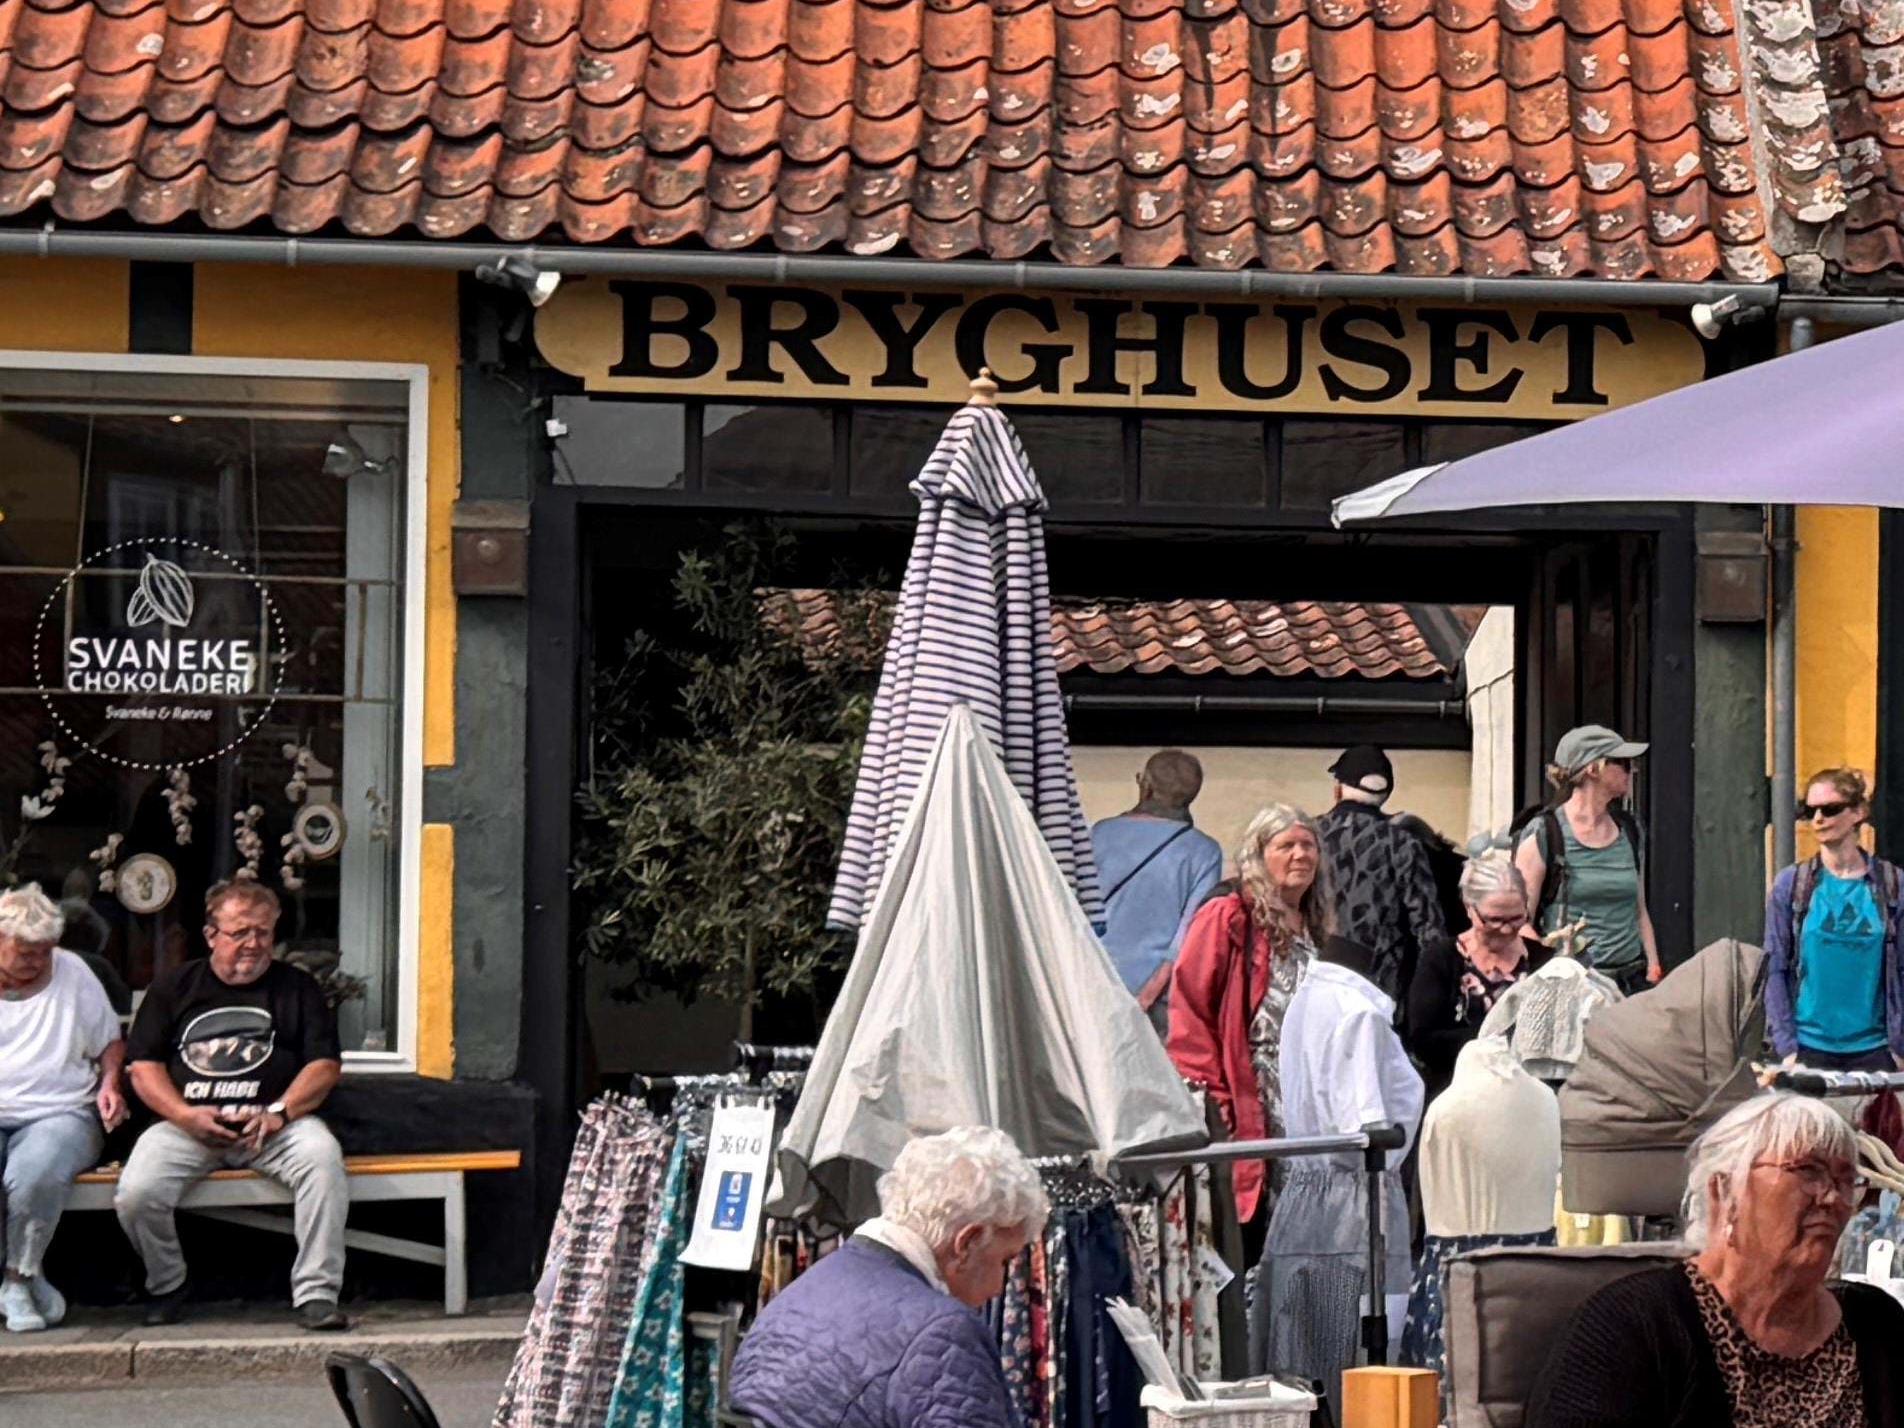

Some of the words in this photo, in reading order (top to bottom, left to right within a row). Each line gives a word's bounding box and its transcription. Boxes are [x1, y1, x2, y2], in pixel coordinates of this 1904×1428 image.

[608, 279, 1635, 406] BRYGHUSET
[68, 637, 250, 670] SVANEKE
[67, 670, 250, 695] CHOKOLADERI
[184, 1080, 212, 1099] ICH
